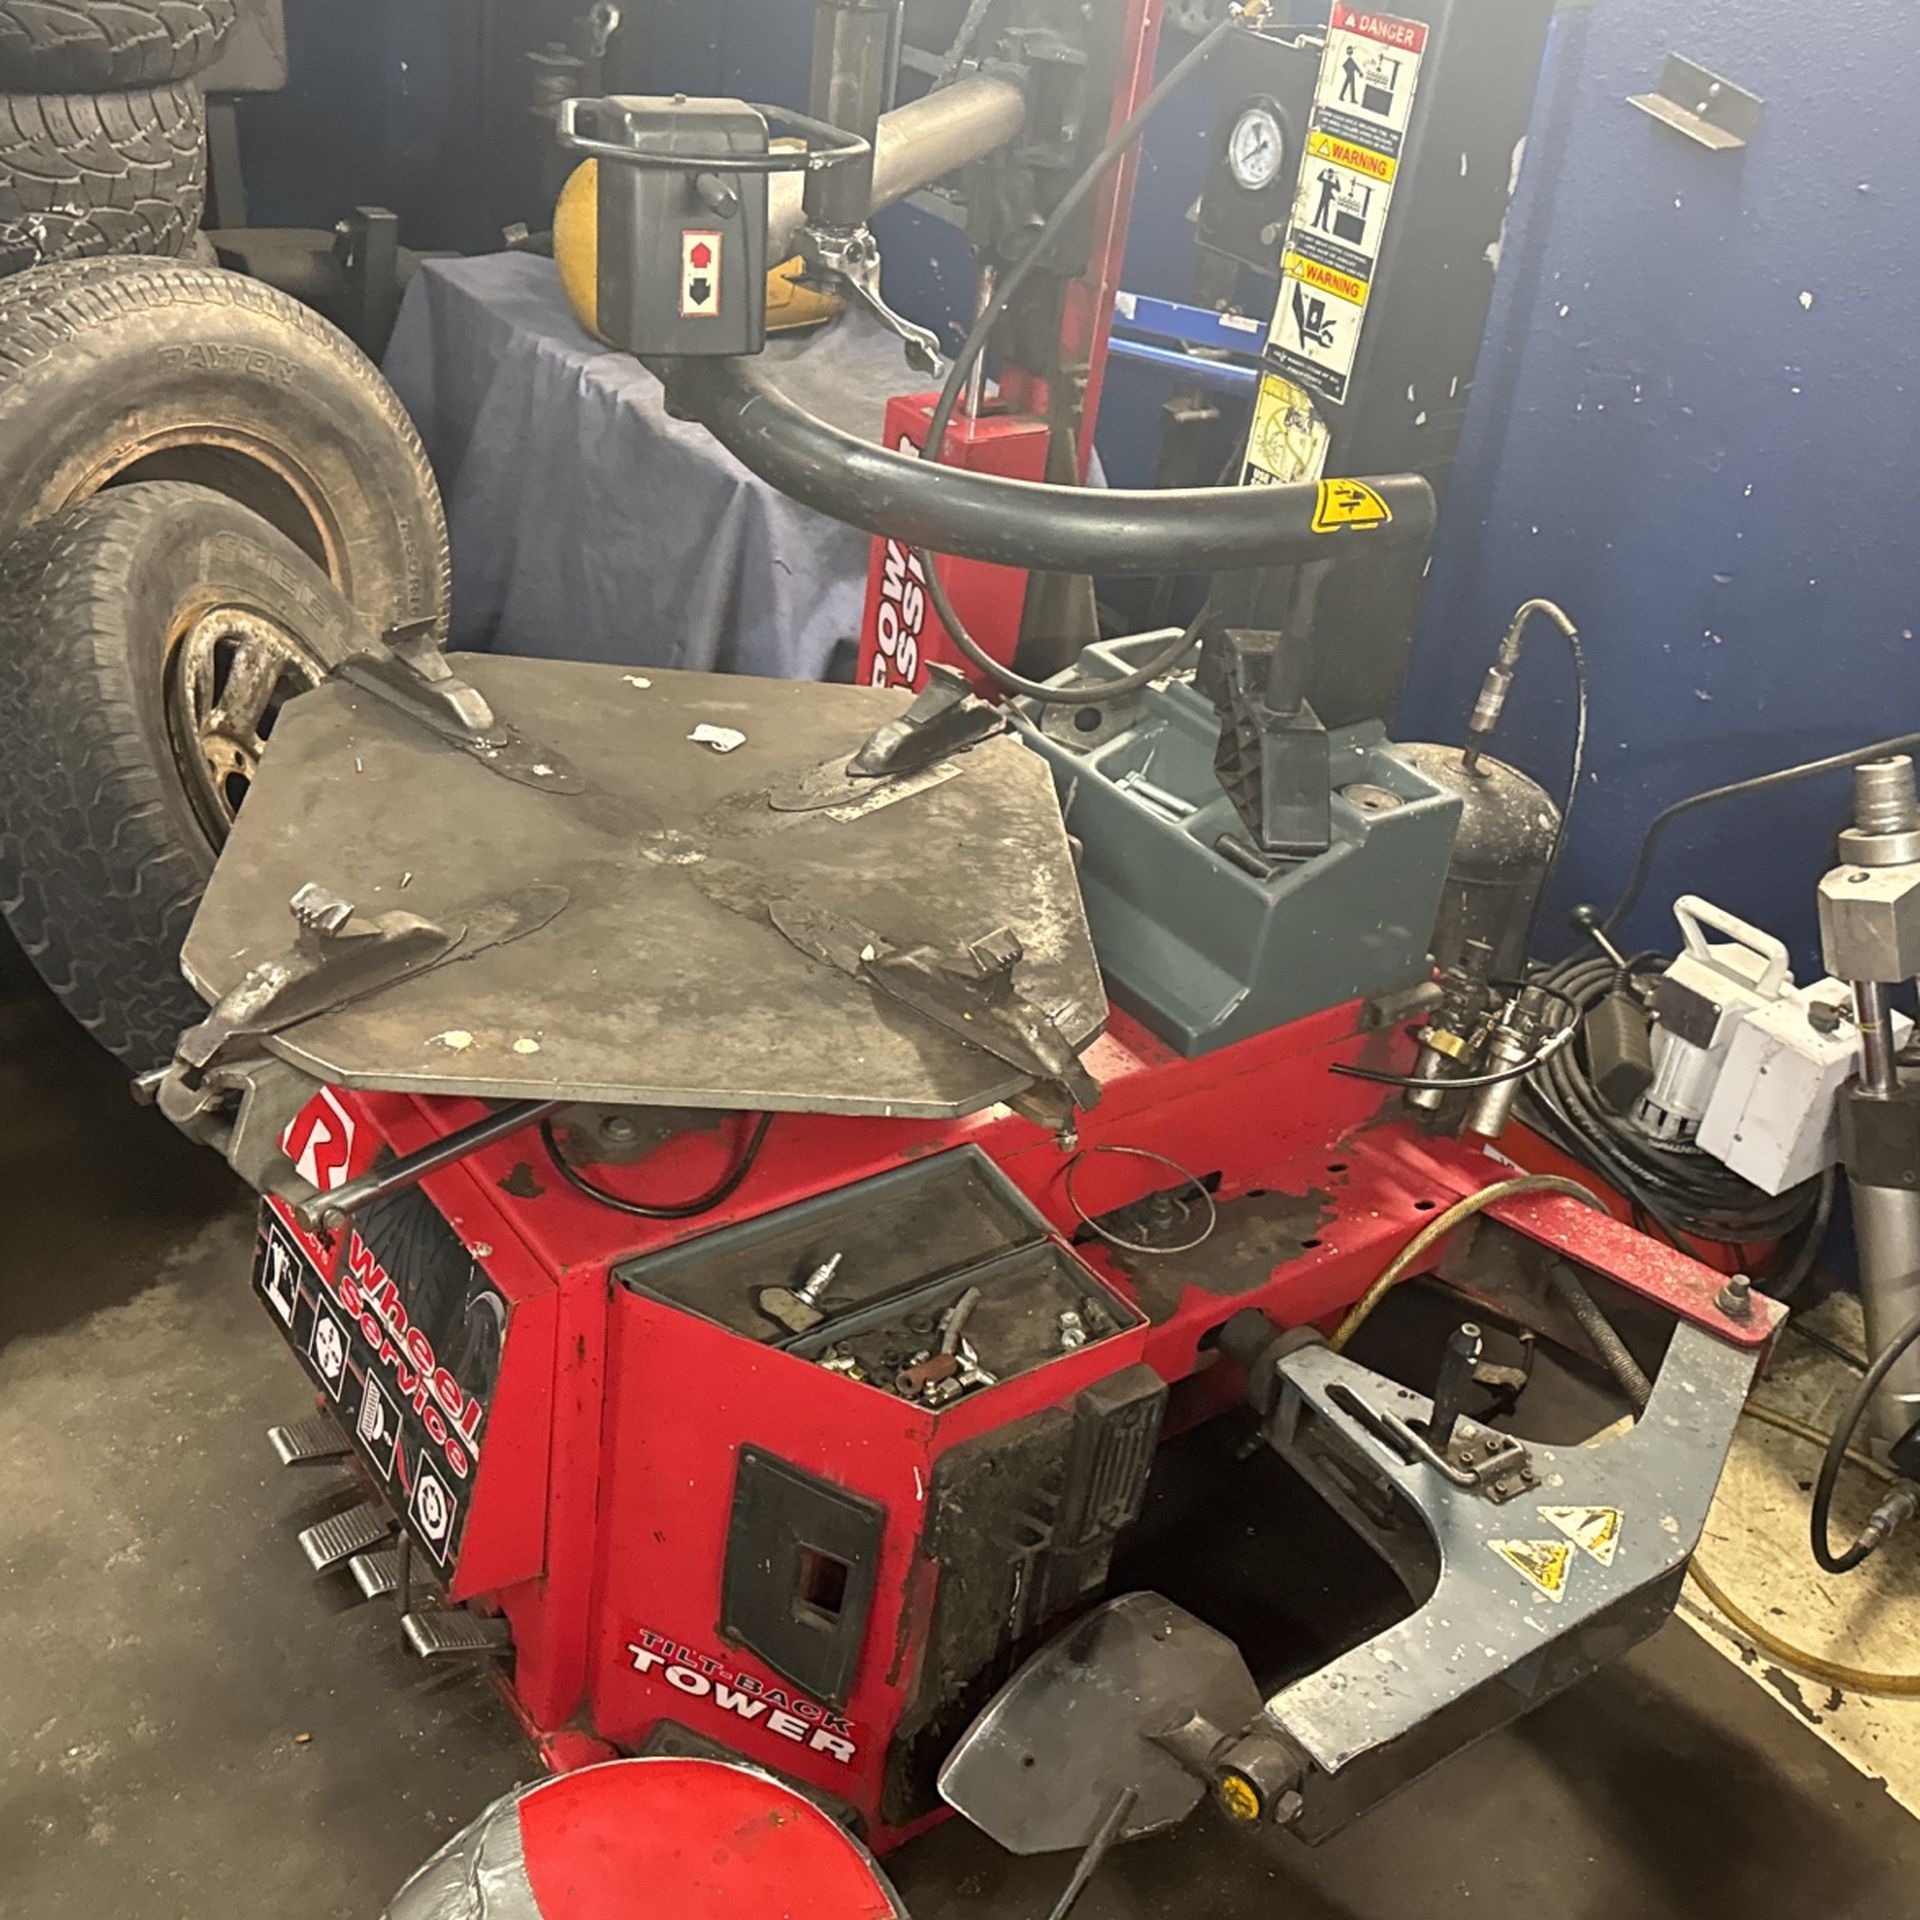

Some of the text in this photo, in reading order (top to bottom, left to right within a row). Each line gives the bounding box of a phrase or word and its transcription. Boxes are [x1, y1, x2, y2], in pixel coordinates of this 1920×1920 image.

[1360, 15, 1415, 46] DANGER
[1332, 143, 1387, 176] WARNING
[1307, 264, 1360, 298] WARNING
[157, 342, 299, 386] DAYTON
[639, 1628, 855, 1737] TILT-BACK
[627, 1644, 856, 1763] TOWER
